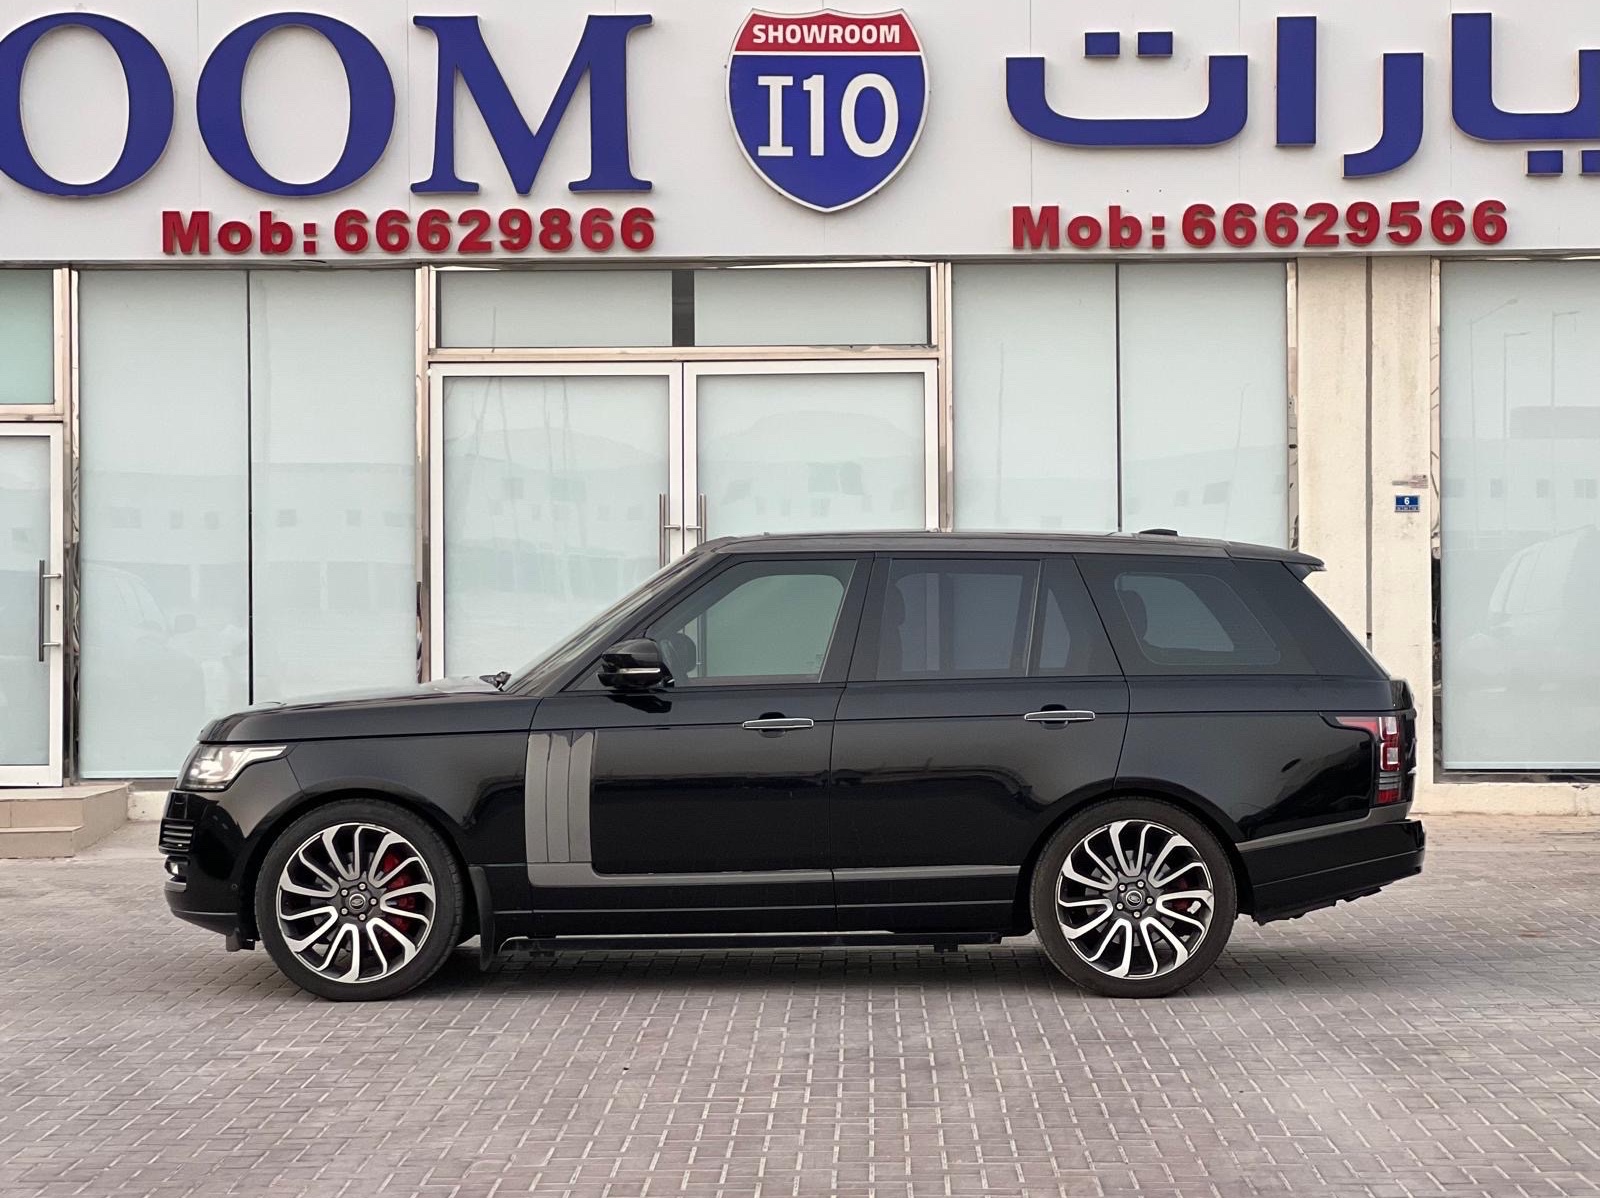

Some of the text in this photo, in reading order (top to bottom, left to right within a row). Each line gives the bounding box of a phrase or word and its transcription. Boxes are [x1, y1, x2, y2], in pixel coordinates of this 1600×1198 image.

[752, 24, 901, 44] SHOWROOM
[757, 72, 899, 158] I10
[1404, 497, 1410, 505] 6
